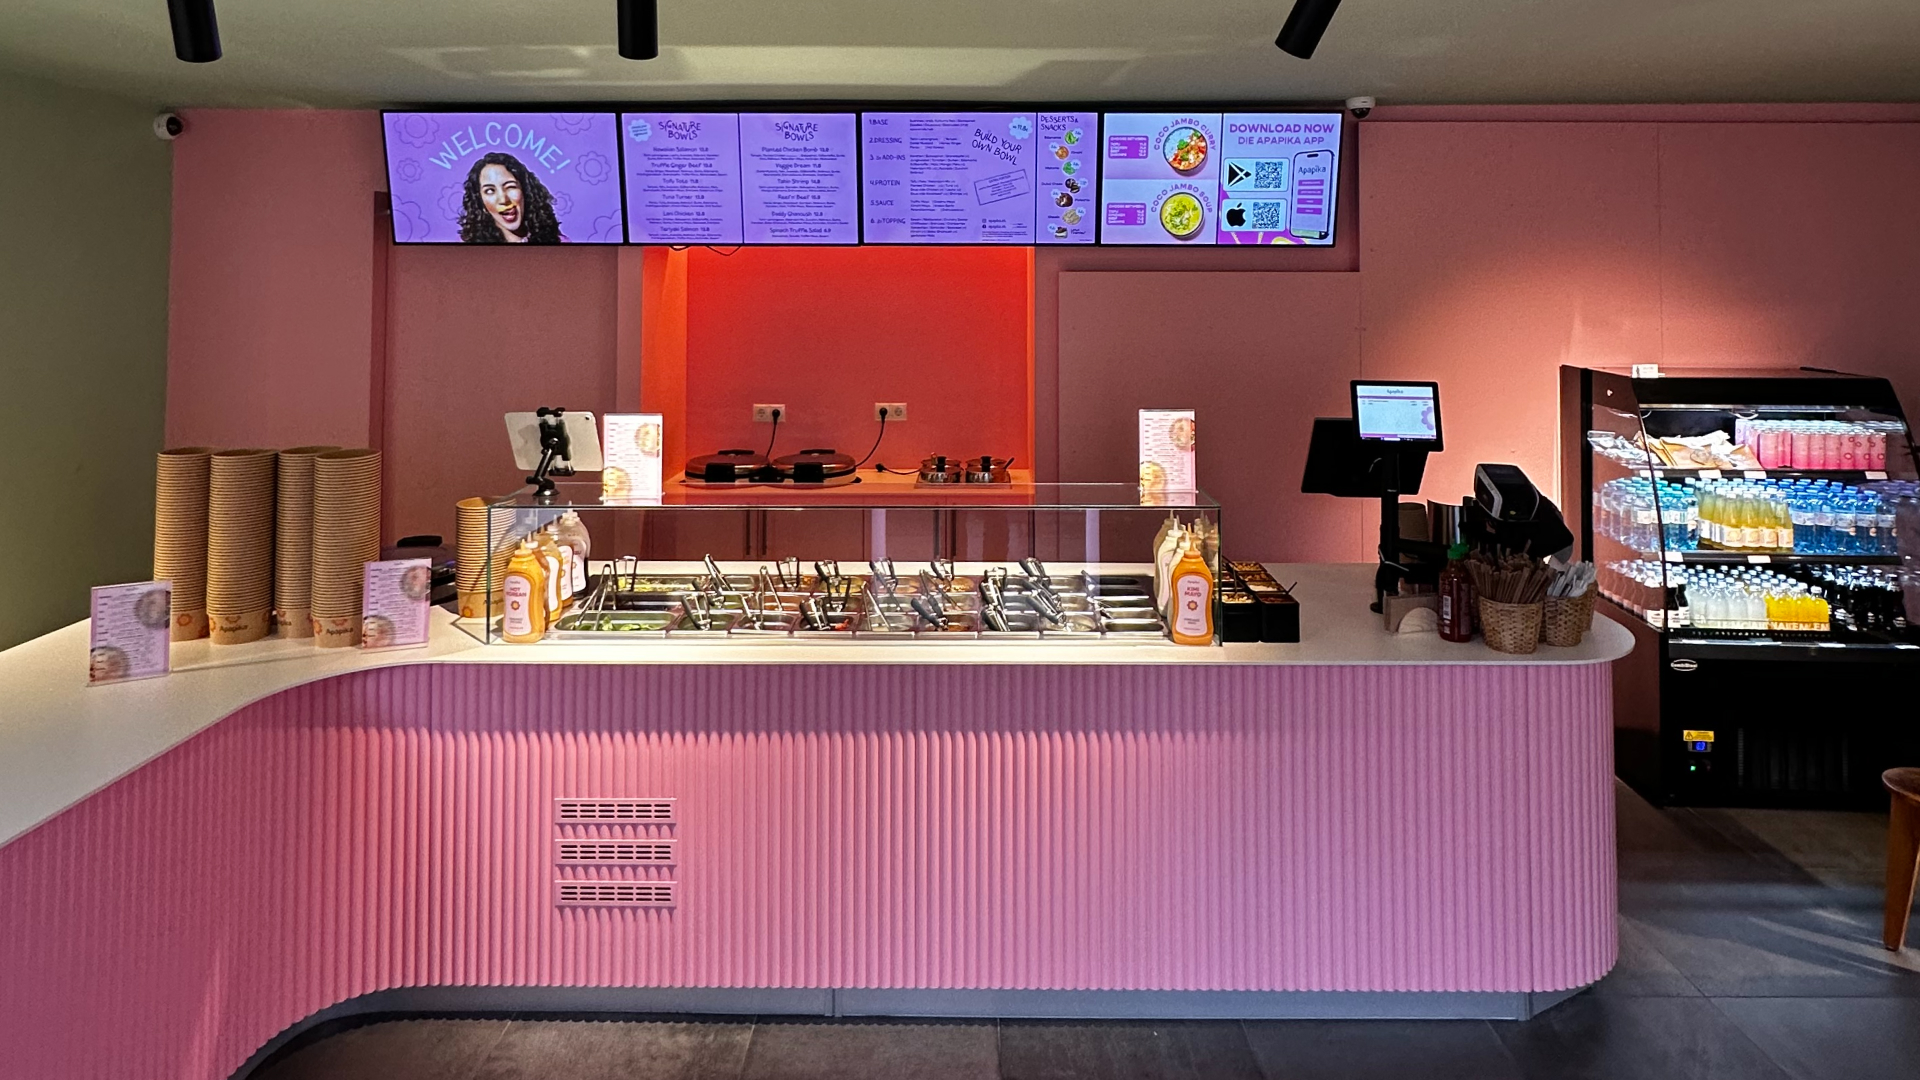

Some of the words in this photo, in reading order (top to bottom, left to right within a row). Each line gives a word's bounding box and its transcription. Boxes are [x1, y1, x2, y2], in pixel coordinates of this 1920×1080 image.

[1040, 115, 1074, 124] DESSERTS
[658, 120, 701, 132] SIGNATURE
[775, 121, 818, 133] SIGNATURE
[1040, 124, 1066, 132] SNACKS
[1230, 124, 1302, 133] DOWNLOAD
[1304, 124, 1334, 133] NOW
[668, 130, 698, 140] BOWLS
[784, 131, 815, 141] BOWLS
[1154, 126, 1170, 150] COCO
[1170, 118, 1200, 128] JAMBO
[1200, 124, 1216, 150] CURRY
[974, 128, 998, 144] BUILD
[1001, 138, 1022, 154] YOUR
[1238, 136, 1255, 144] DIE
[1256, 136, 1301, 144] APAPIKA
[1303, 136, 1324, 144] APP
[429, 121, 571, 174] WELCOME!
[972, 139, 993, 152] OWN
[993, 147, 1018, 166] BOWL
[1151, 190, 1168, 212] COCO
[1170, 184, 1199, 193] JAMBO
[1199, 192, 1213, 213] SOUP
[219, 624, 248, 634] Apapika
[326, 627, 354, 636] Apapika
